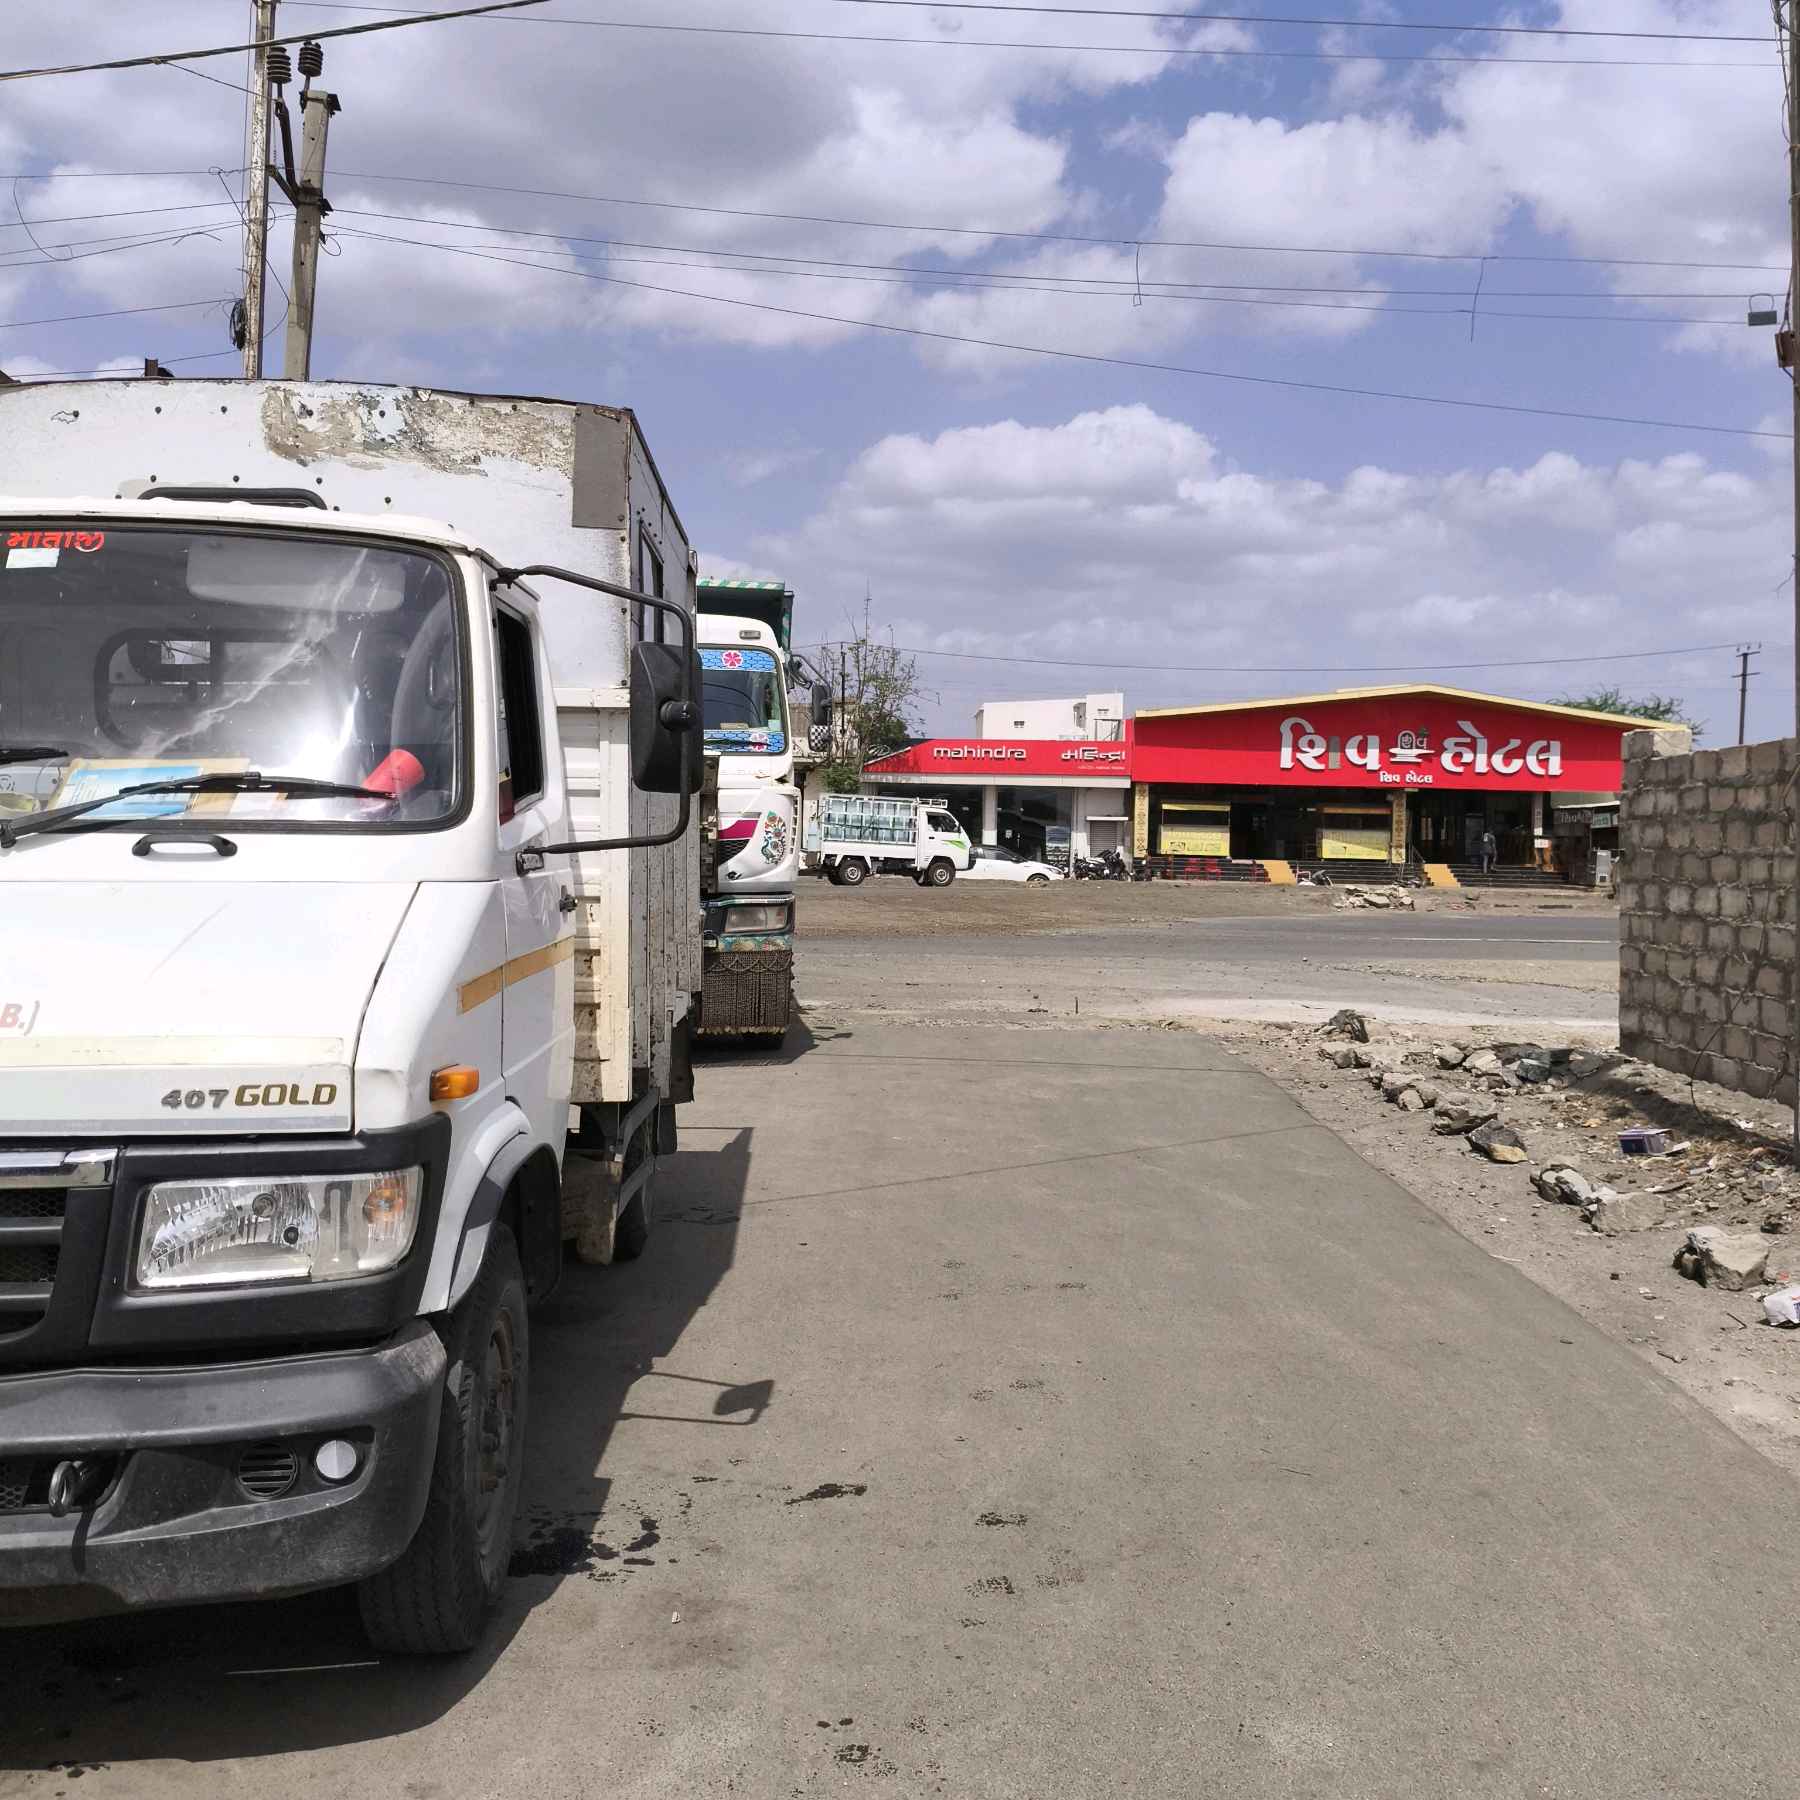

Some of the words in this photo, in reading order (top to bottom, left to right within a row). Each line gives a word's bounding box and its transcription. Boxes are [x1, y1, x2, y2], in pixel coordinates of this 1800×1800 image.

[933, 745, 1027, 759] mahindra
[1279, 717, 1382, 770] શિવ
[1440, 720, 1564, 776] હોટલ
[1379, 770, 1401, 783] શિવ
[1405, 770, 1433, 783] હોટલ
[160, 1089, 230, 1109] 407
[234, 1083, 338, 1107] GOLD
